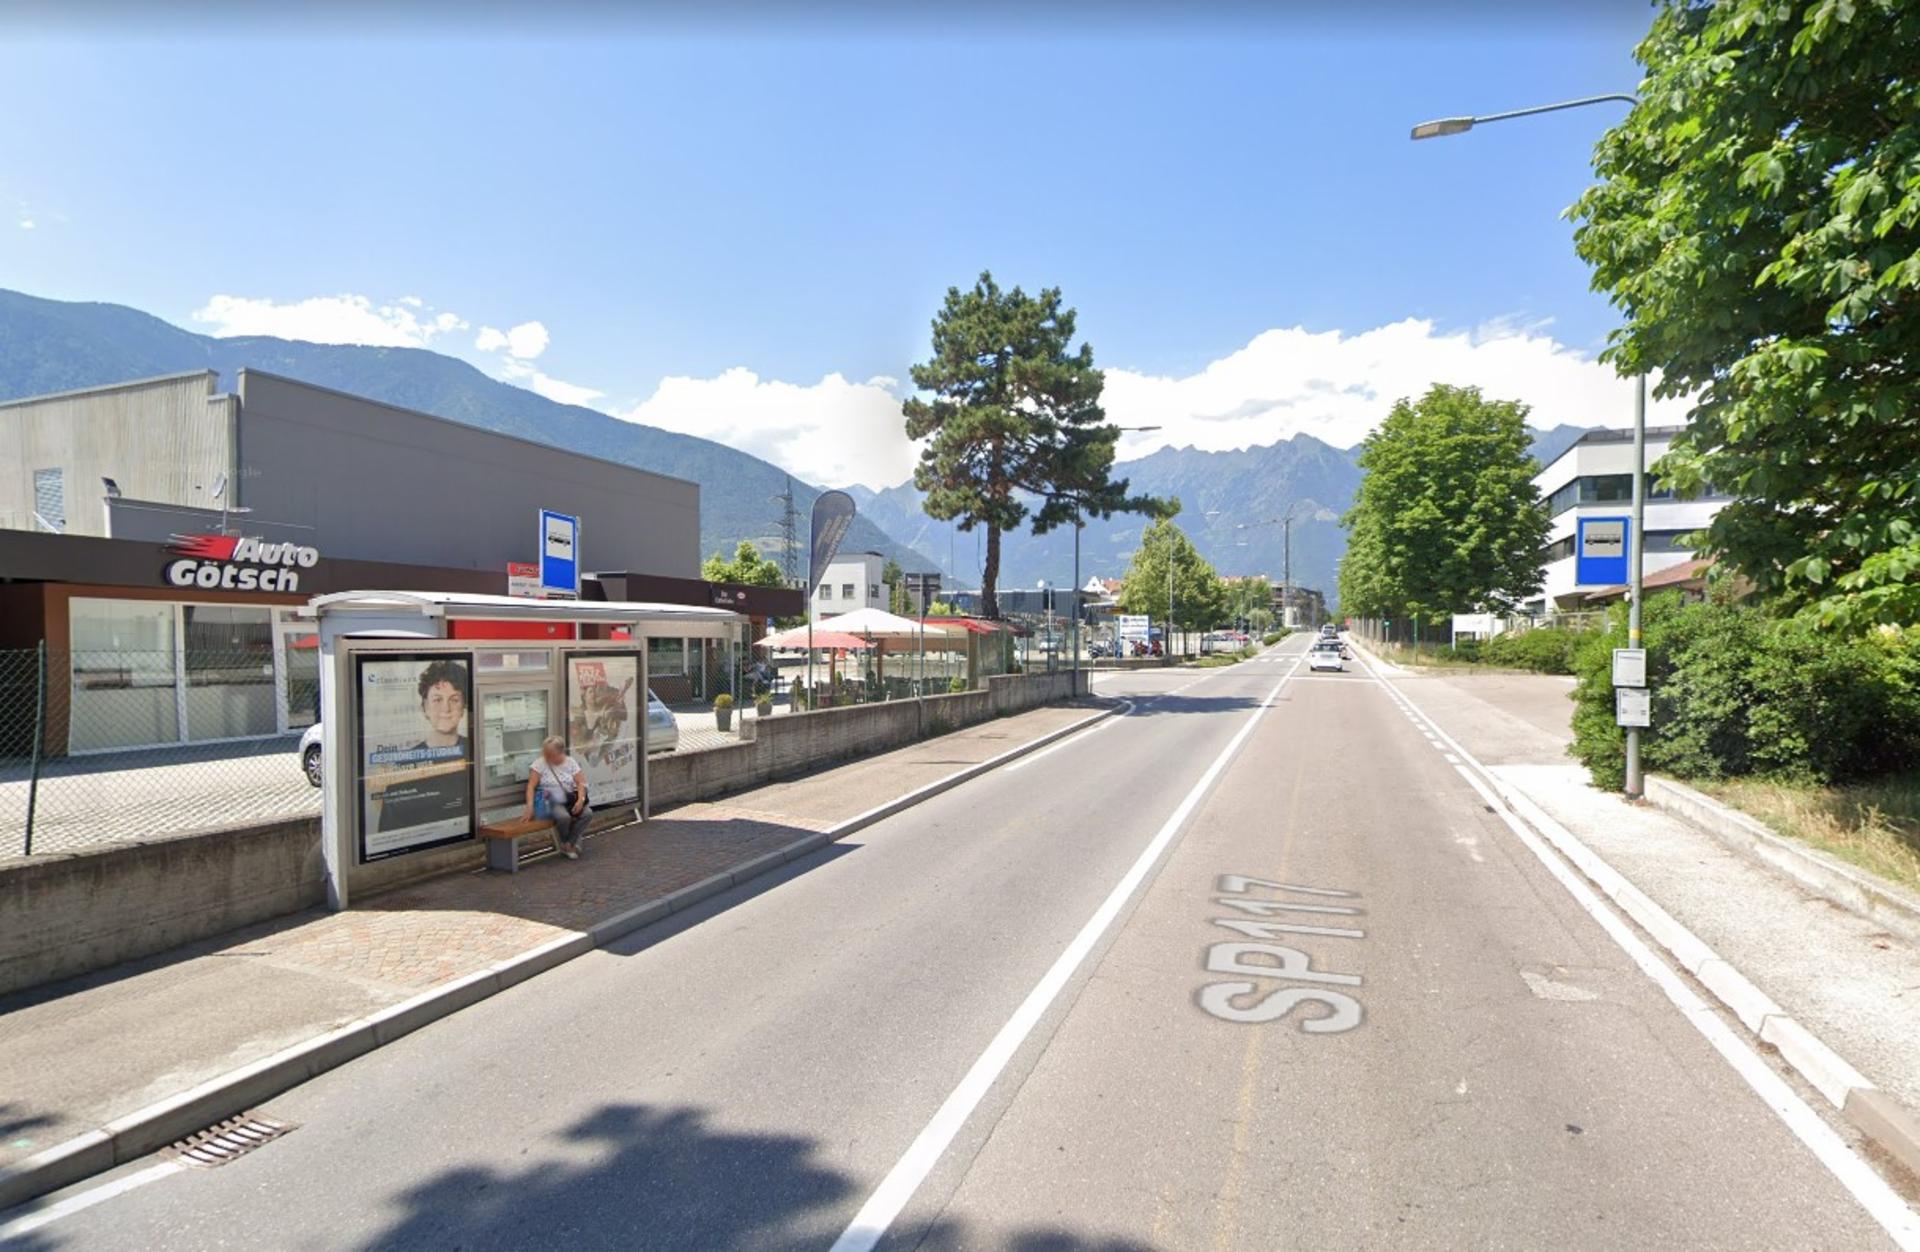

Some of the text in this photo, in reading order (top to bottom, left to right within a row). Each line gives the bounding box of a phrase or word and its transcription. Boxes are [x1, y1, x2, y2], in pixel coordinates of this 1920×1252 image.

[233, 538, 319, 568] Auto
[170, 560, 299, 592] Götsch
[376, 744, 398, 753] Dein
